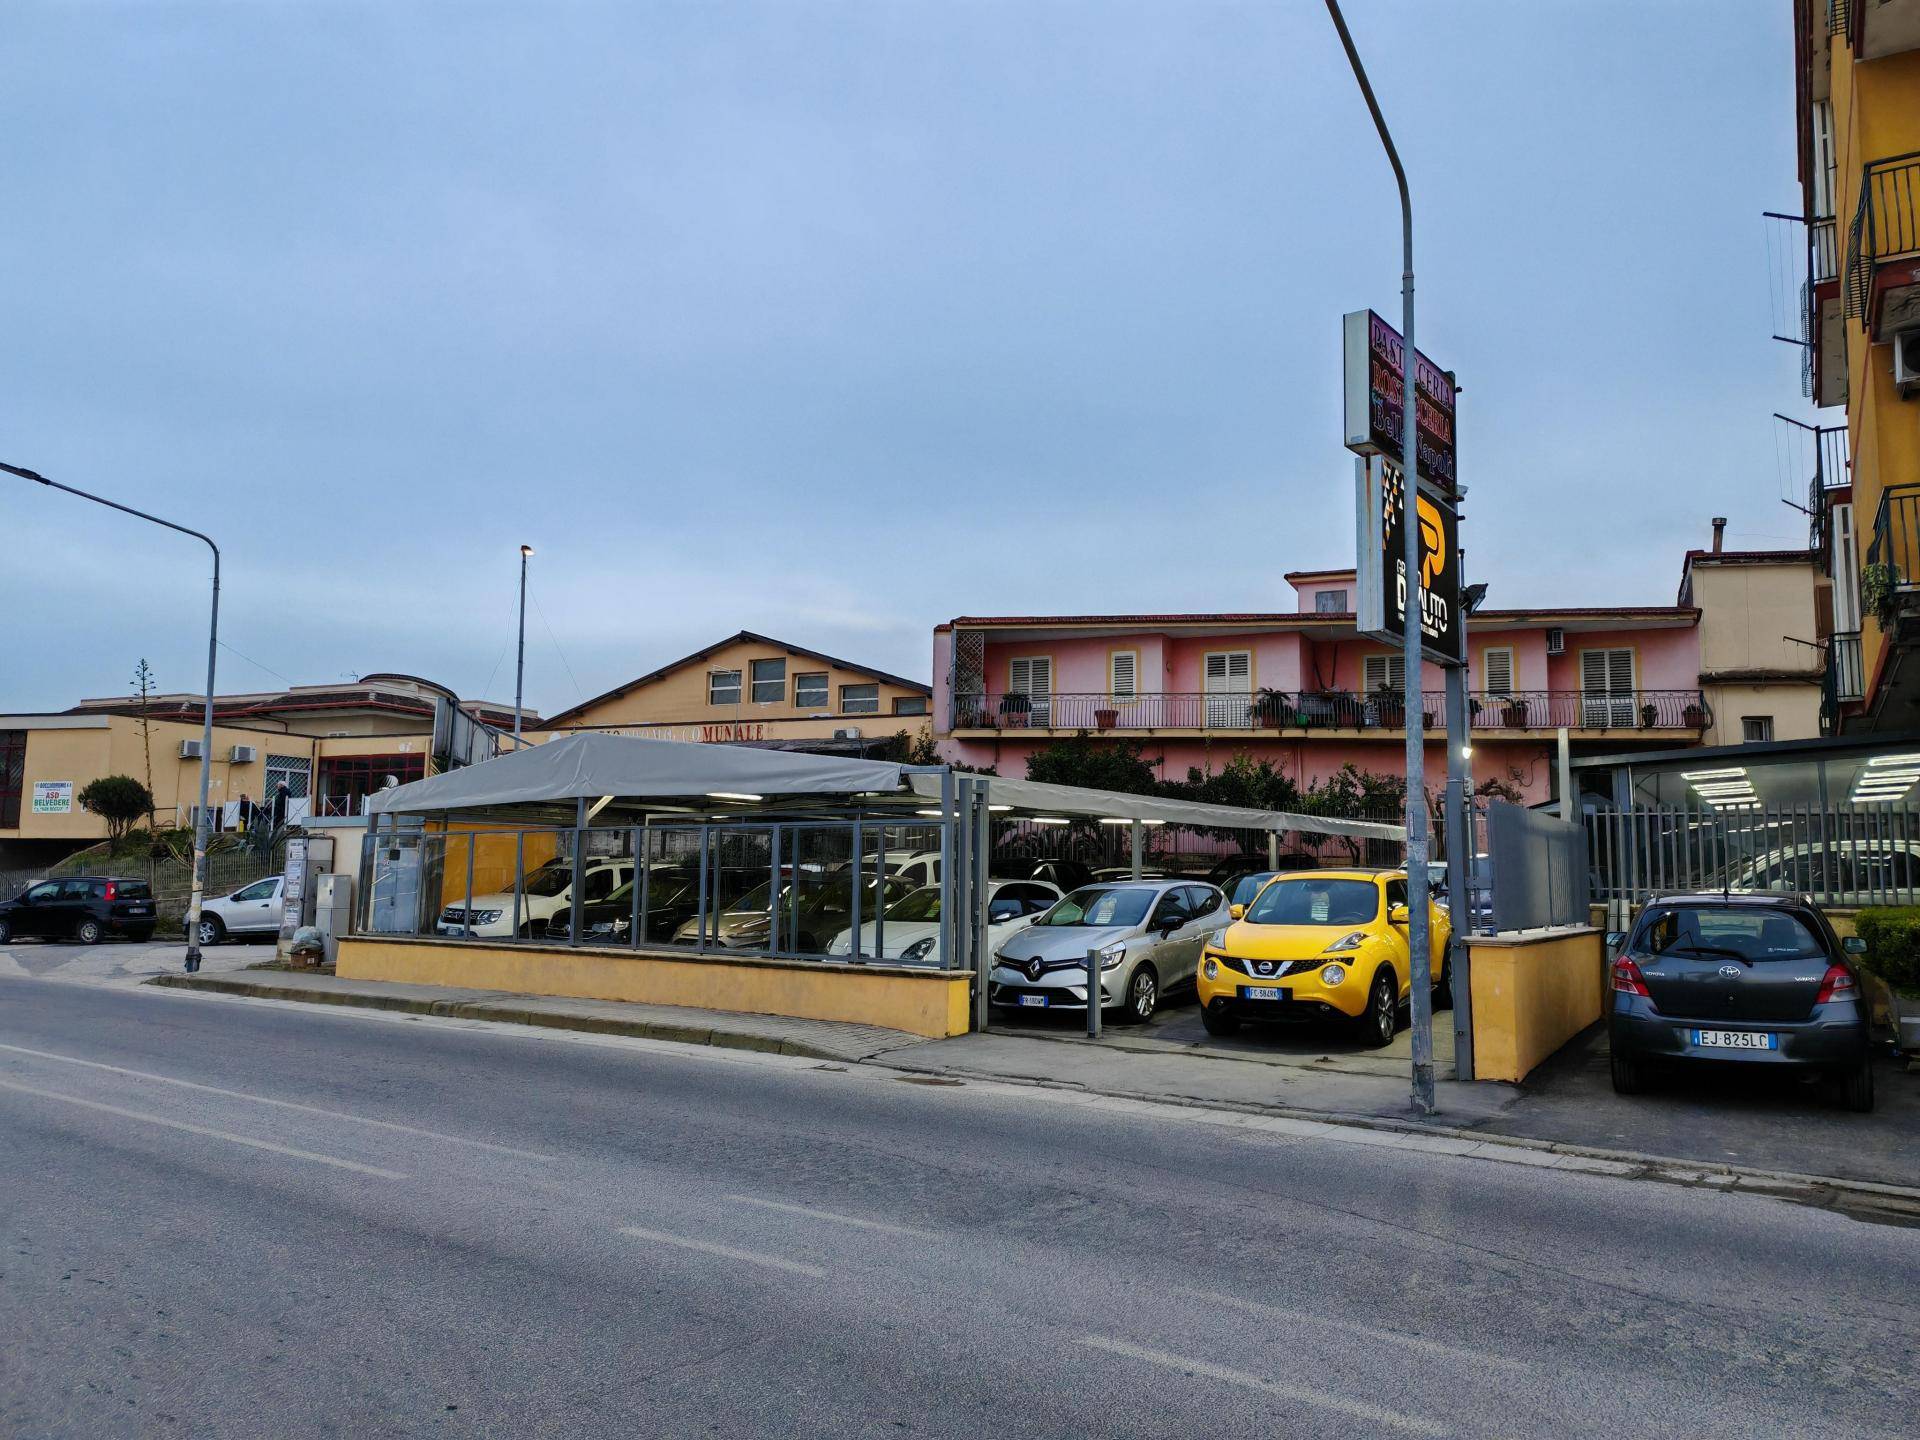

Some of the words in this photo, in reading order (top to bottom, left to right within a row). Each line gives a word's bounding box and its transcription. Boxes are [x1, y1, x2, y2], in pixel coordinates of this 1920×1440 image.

[1374, 403, 1405, 446] Bell
[45, 791, 60, 799] ASD
[34, 799, 70, 807] BELVEDERE
